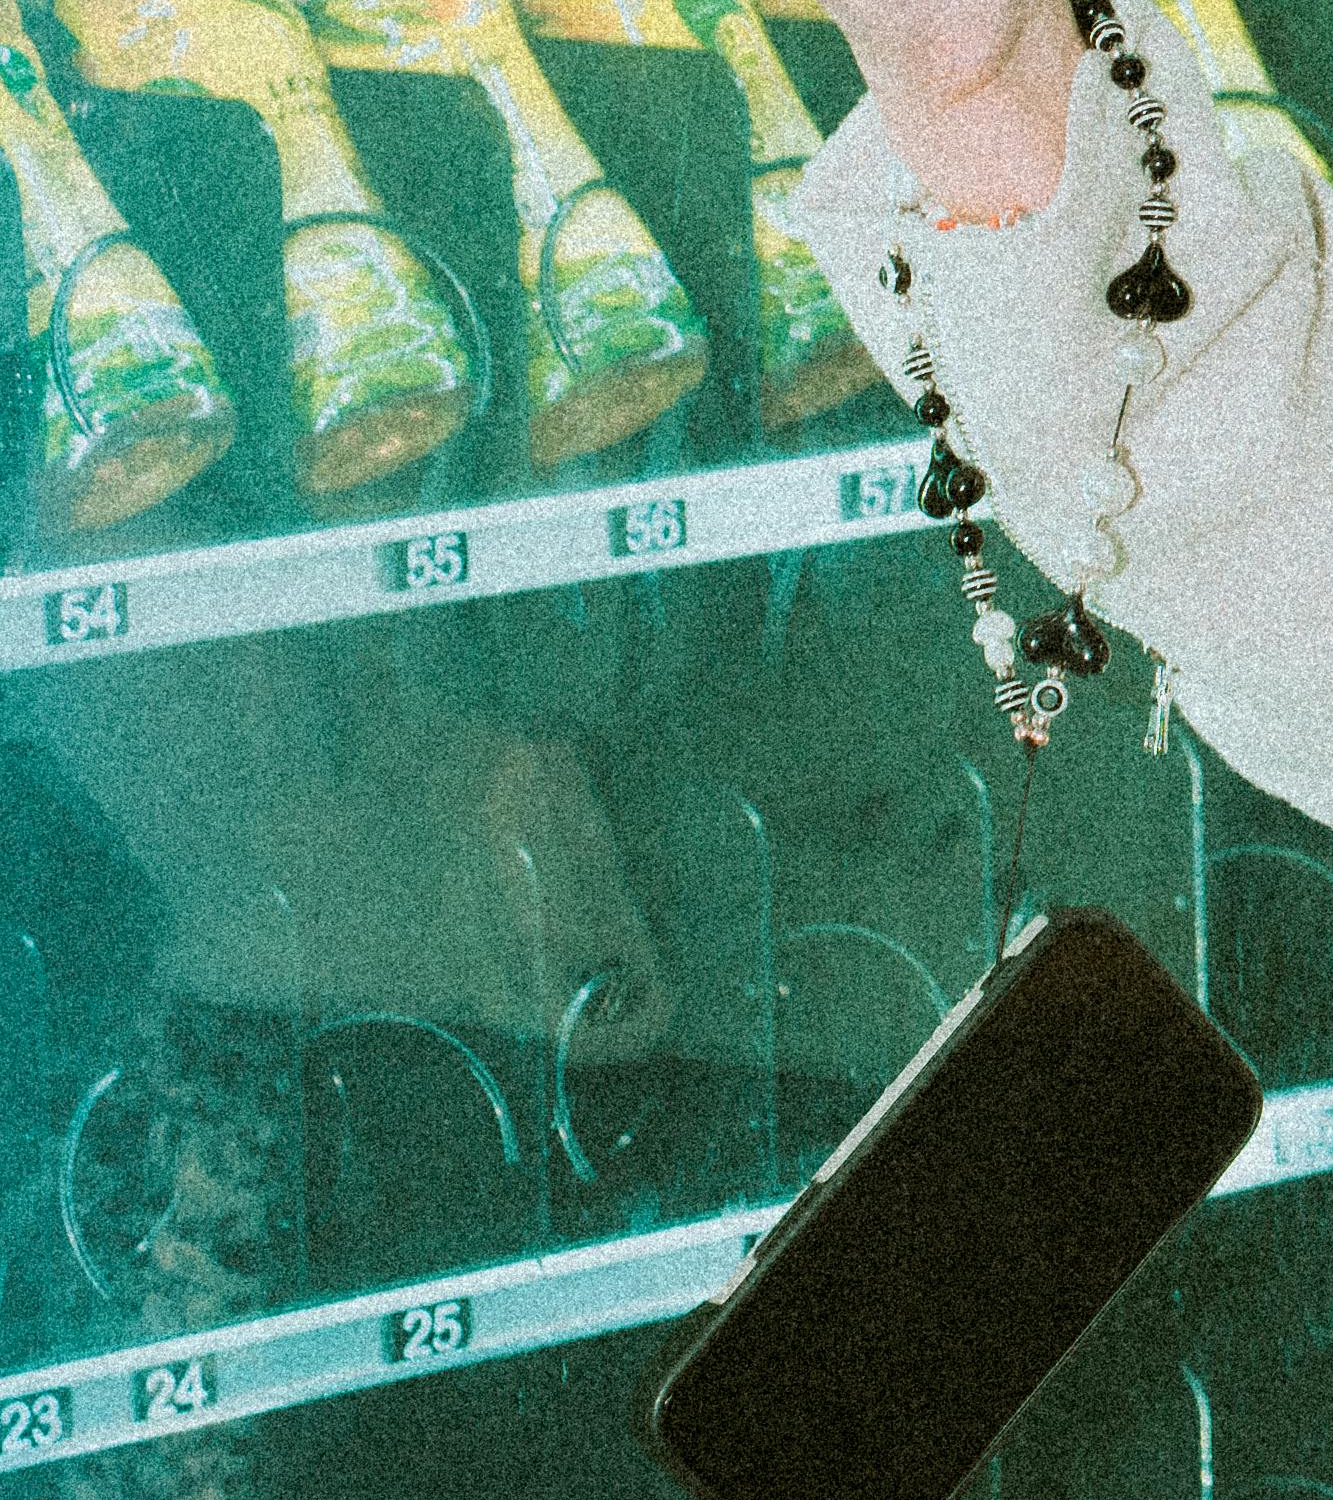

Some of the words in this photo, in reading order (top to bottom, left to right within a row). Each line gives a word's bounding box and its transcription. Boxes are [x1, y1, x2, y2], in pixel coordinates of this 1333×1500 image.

[60, 582, 122, 643] 54
[407, 533, 464, 590] 55
[625, 496, 683, 555] 56
[859, 465, 909, 522] 57
[0, 1392, 62, 1450] 23
[145, 1360, 208, 1422] 24
[402, 1298, 464, 1363] 25
